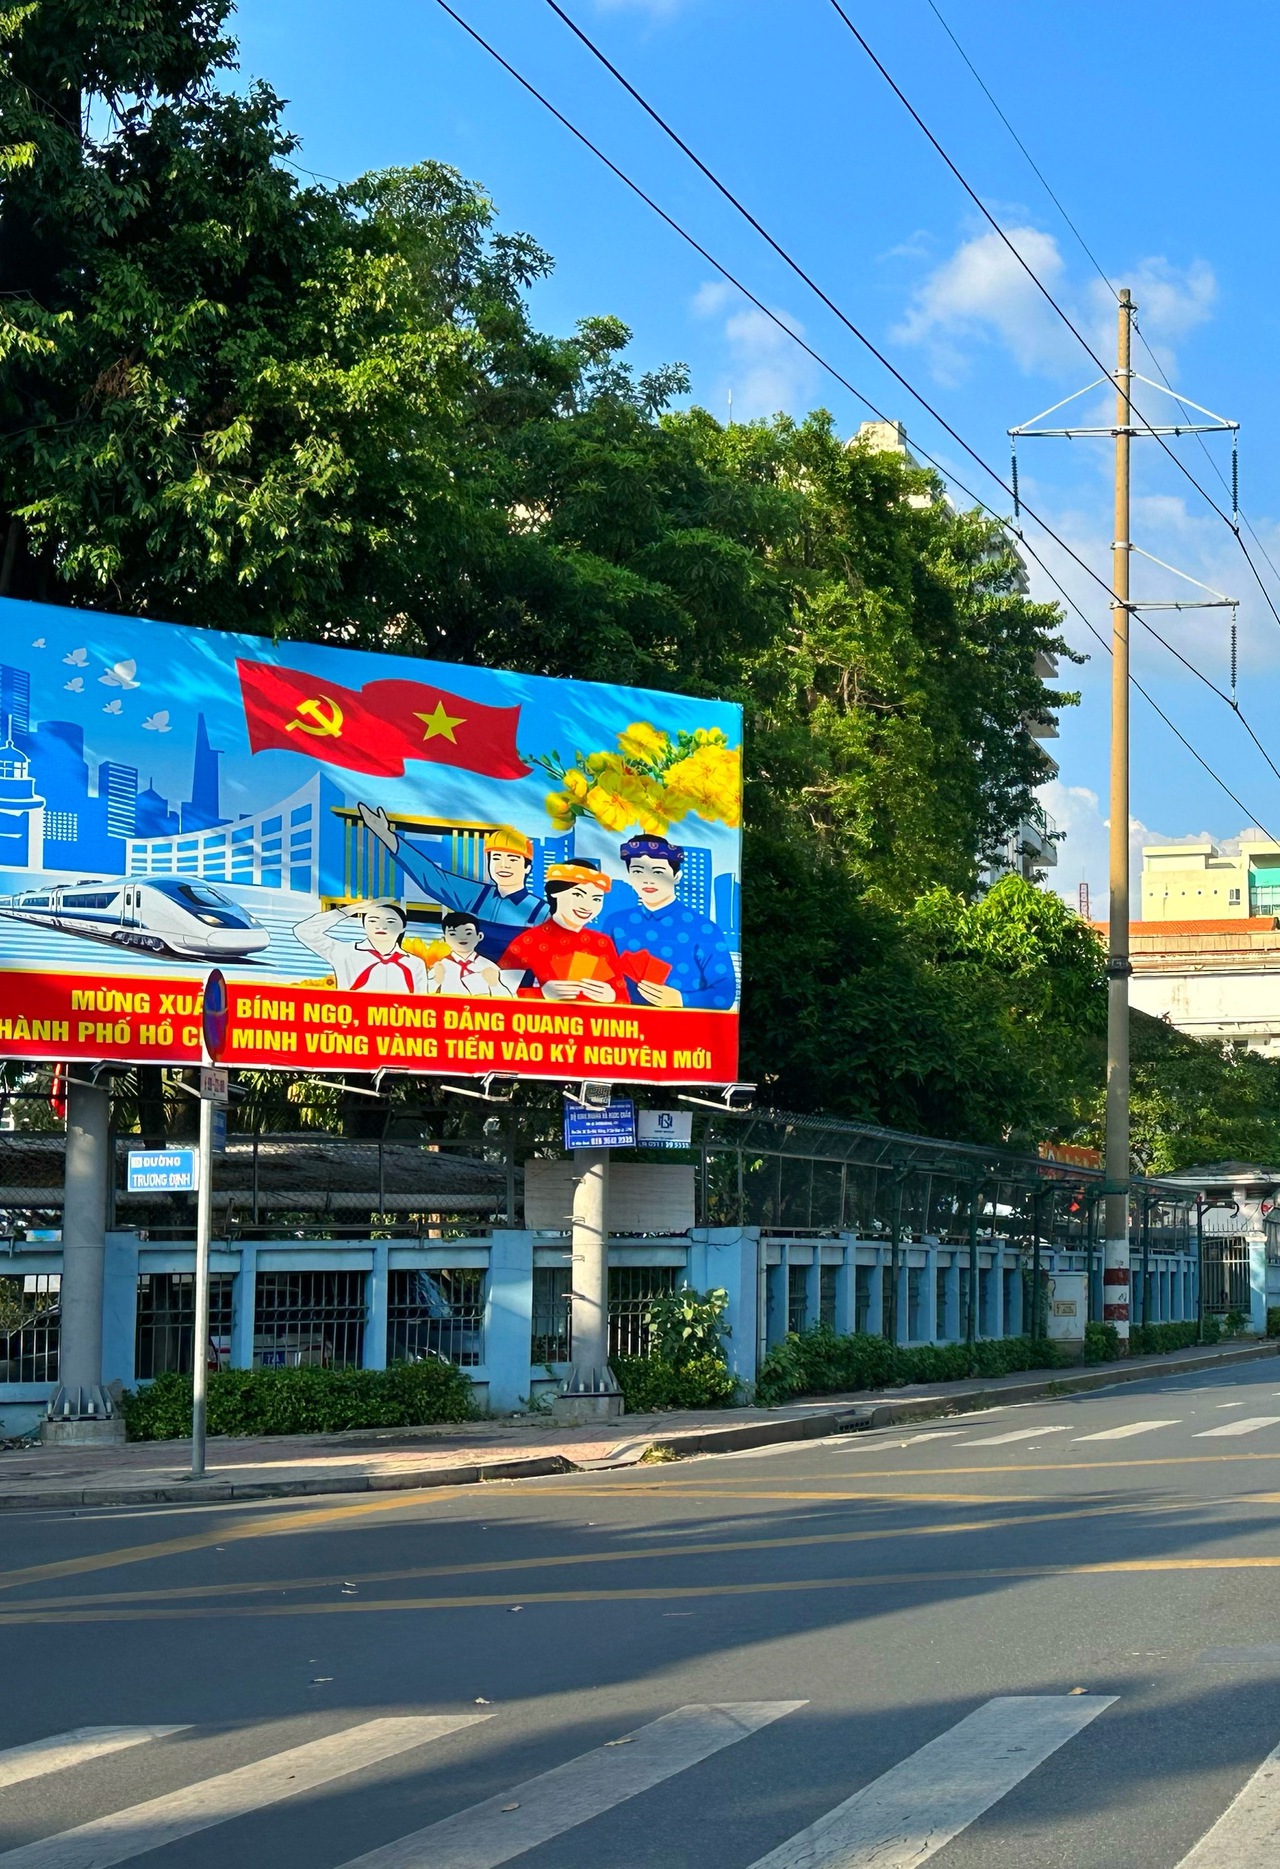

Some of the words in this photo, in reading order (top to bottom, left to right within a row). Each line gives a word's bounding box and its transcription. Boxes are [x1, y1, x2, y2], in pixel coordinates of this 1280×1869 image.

[0, 1014, 69, 1042] HÀNH
[78, 1017, 131, 1044] PHỐ
[139, 1018, 174, 1046] HỒ
[232, 1028, 298, 1052] MINH
[304, 1030, 369, 1056] VỮNG
[376, 1033, 438, 1058] VÀNG
[444, 1034, 495, 1060] TIẾN
[501, 1039, 544, 1062] VÀO
[550, 1039, 578, 1064] KỶ
[583, 1045, 667, 1069] NGUYÊN
[673, 1047, 712, 1070] MỚI
[71, 987, 151, 1014] MỪNG
[158, 993, 206, 1016] XUÂ
[236, 995, 296, 1022] BÍNH
[303, 1002, 360, 1028] NGỌ,
[367, 1004, 437, 1029] MỪNG
[443, 1005, 505, 1032] ĐẢNG
[511, 1013, 584, 1036] QUANG
[589, 1017, 645, 1042] VINH,
